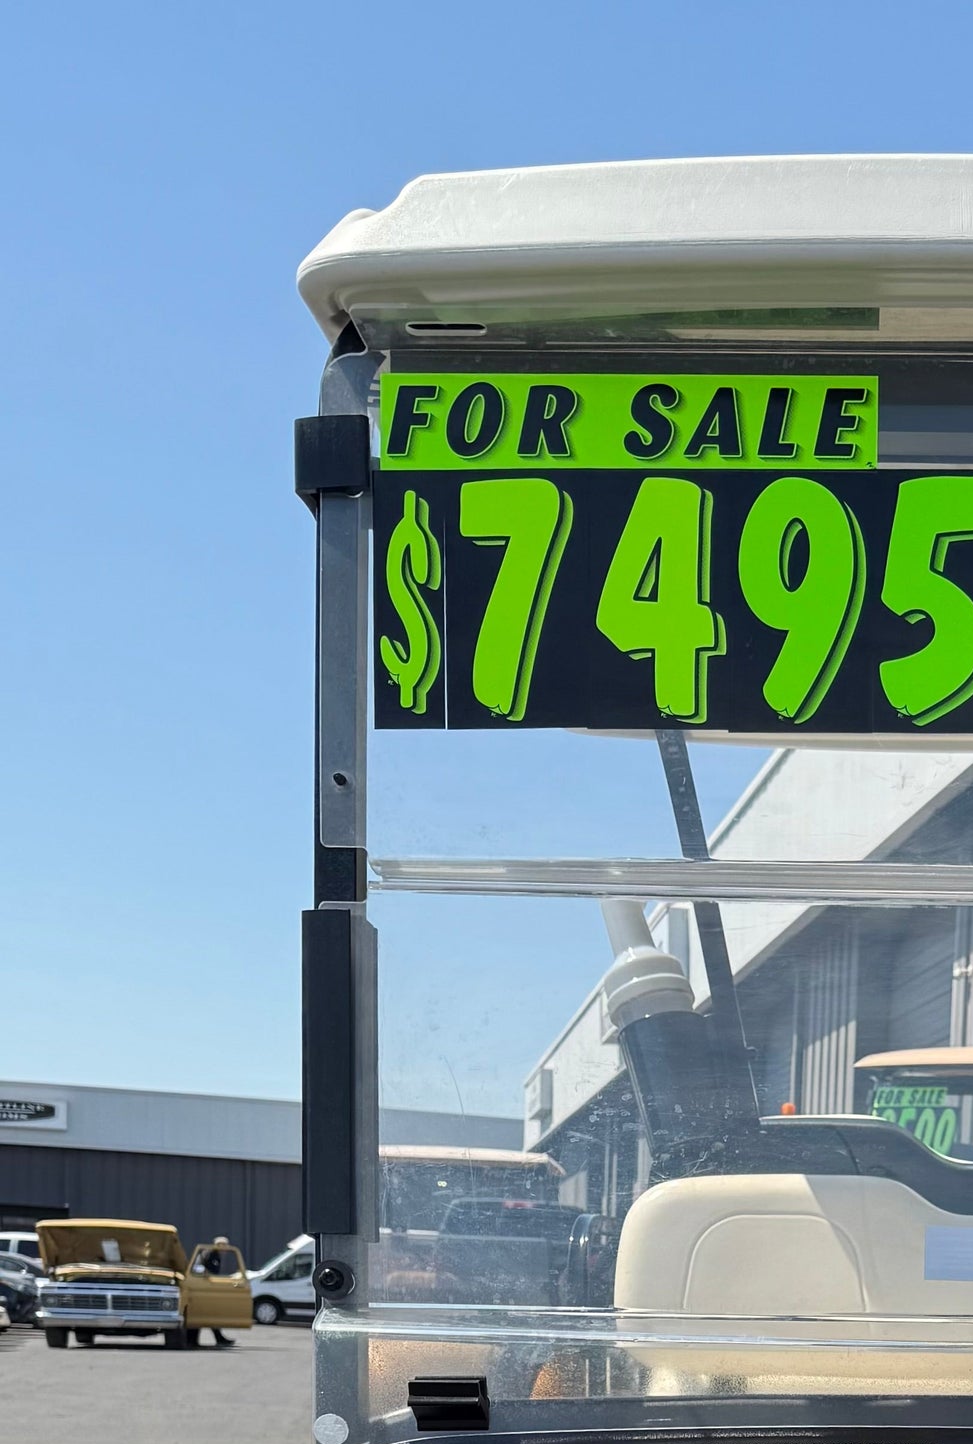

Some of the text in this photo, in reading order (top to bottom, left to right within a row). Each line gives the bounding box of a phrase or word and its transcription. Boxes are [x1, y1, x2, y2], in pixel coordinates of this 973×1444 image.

[386, 381, 870, 460] FOR SALE
[879, 1088, 946, 1105] FOR SALE
